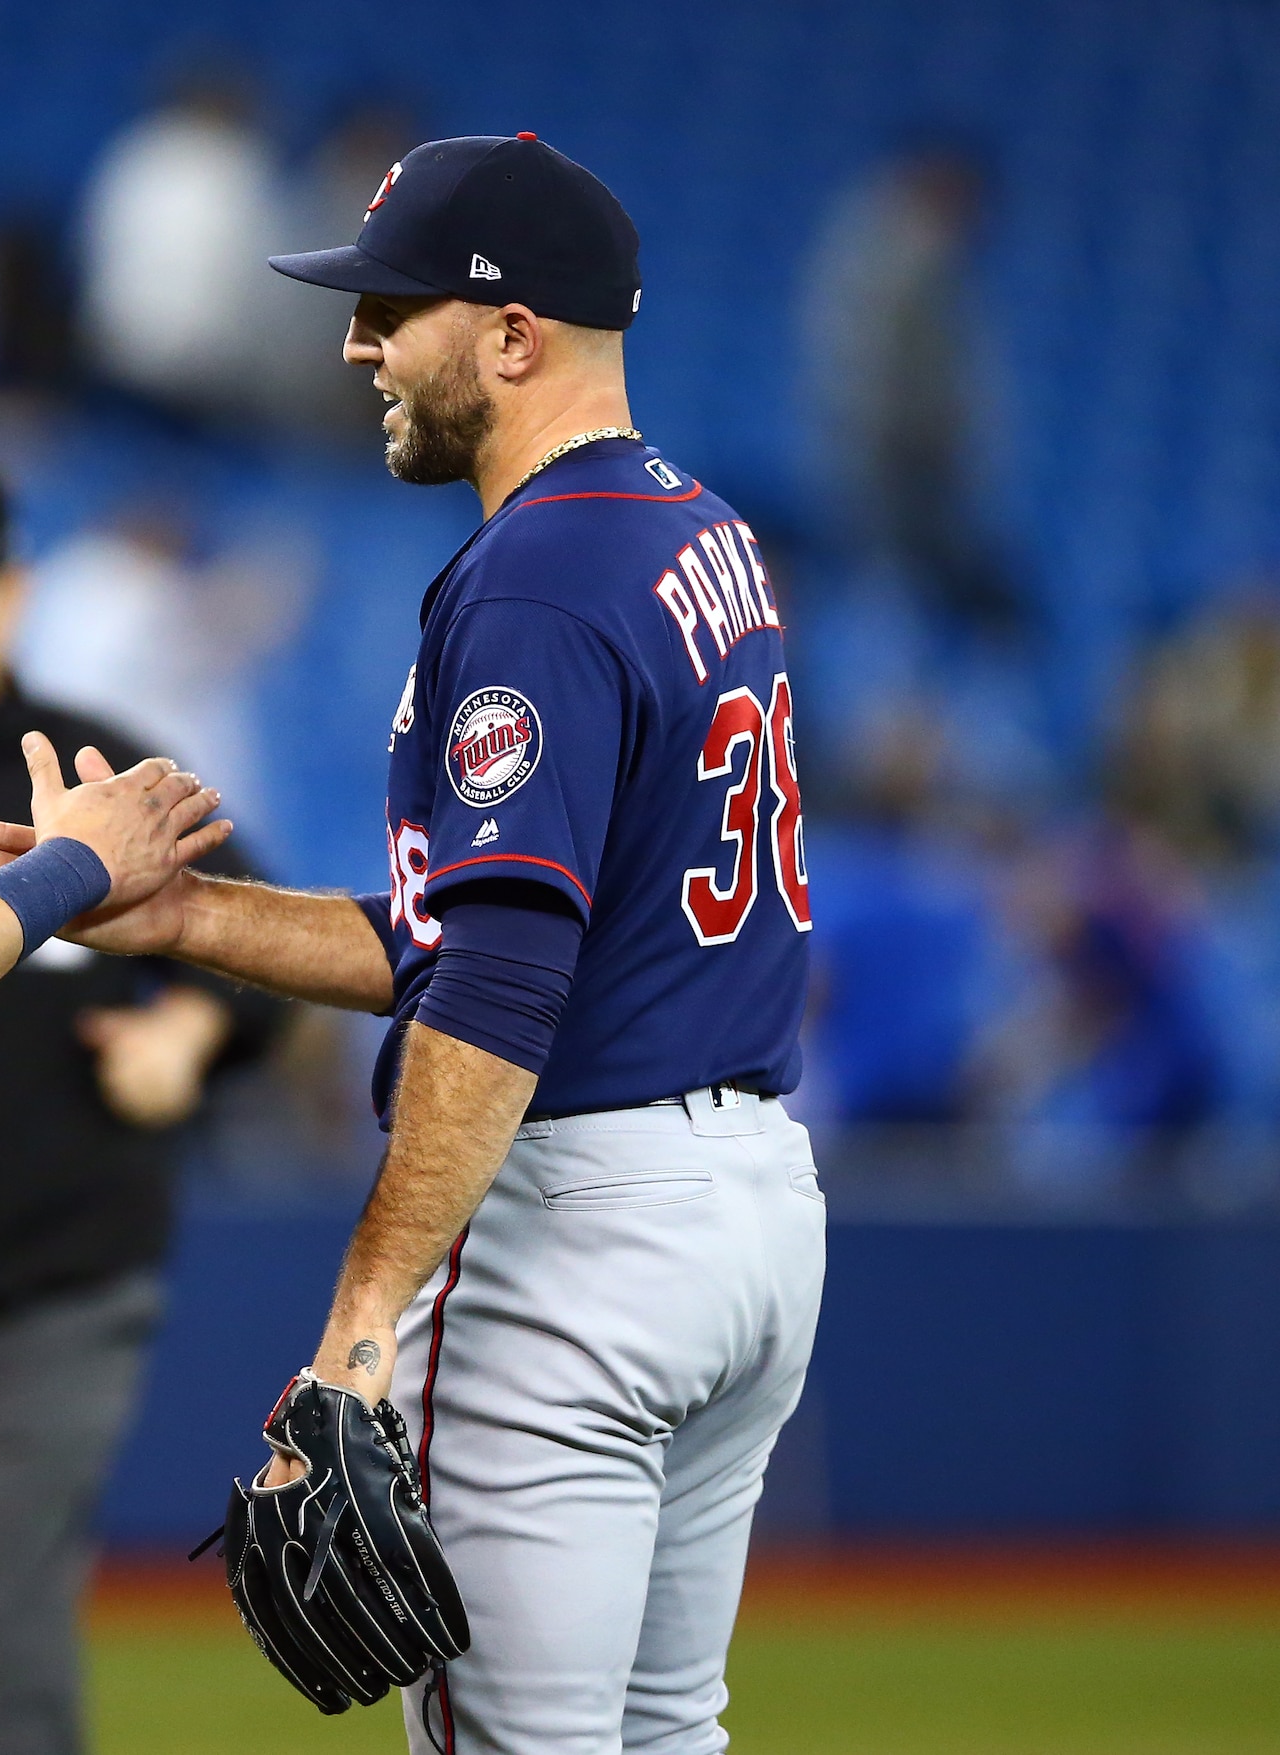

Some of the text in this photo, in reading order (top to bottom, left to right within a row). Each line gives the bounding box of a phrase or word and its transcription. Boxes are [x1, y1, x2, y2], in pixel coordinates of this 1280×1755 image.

[453, 692, 527, 737] MINNESOTA
[451, 714, 532, 780] Twins
[459, 760, 531, 801] BASEBALL CLUB
